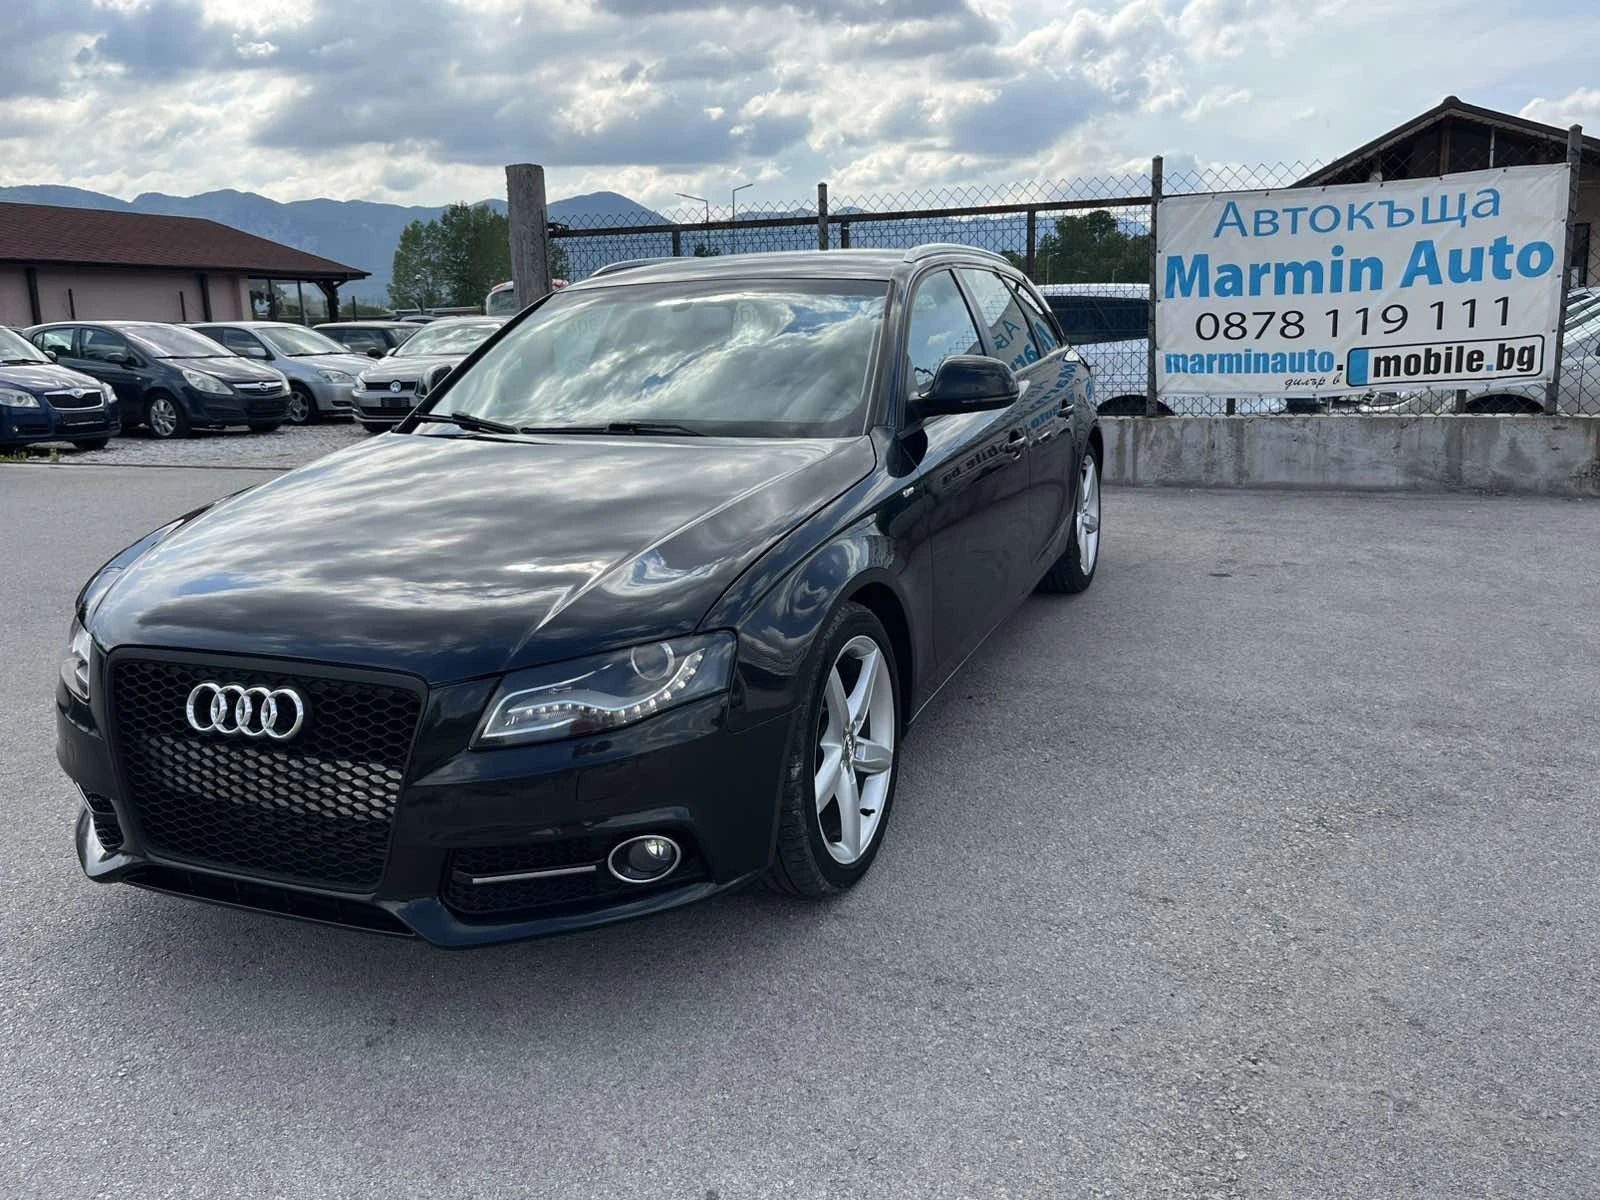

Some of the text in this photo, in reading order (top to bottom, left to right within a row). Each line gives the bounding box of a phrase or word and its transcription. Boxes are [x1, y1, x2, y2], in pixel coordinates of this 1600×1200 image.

[1214, 188, 1501, 238] Автокъща
[1164, 235, 1555, 299] Marmin Auto
[1196, 297, 1509, 340] 0878 119 111
[1373, 343, 1535, 377] mobile.bg
